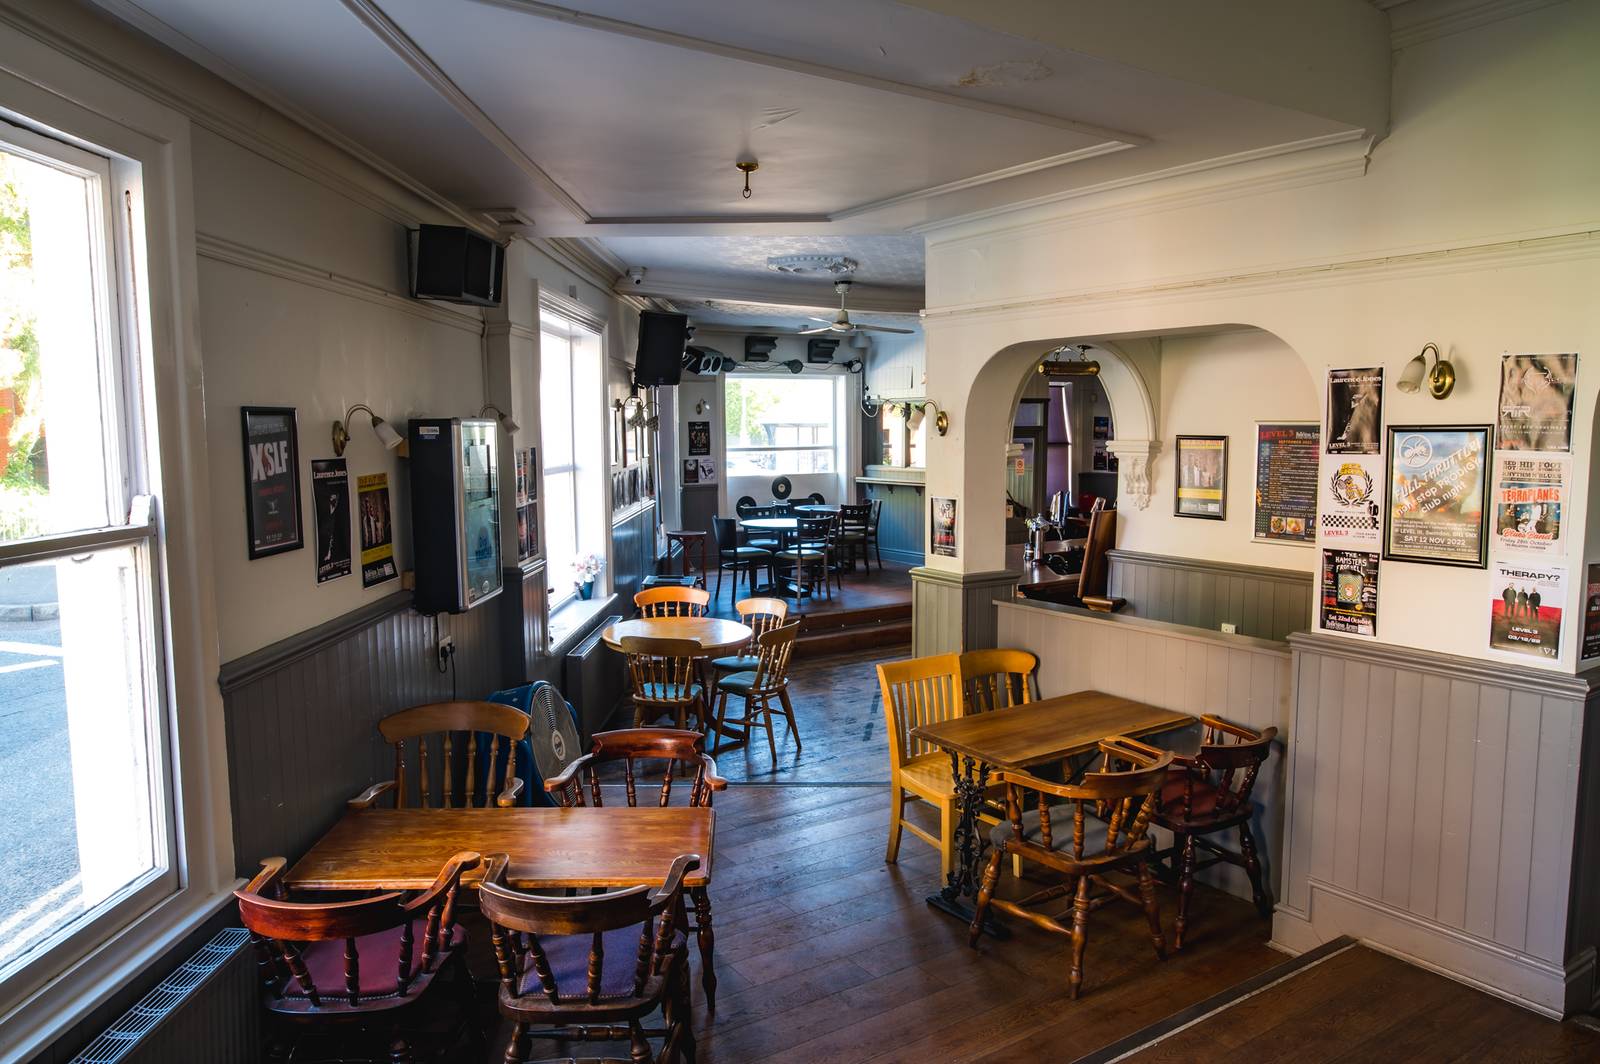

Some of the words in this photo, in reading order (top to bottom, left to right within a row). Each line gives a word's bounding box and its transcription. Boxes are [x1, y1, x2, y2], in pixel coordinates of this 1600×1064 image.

[1260, 431, 1289, 439] LEVEL
[249, 440, 288, 481] XSLF
[1416, 486, 1438, 503] stop
[1436, 455, 1480, 489] PRODIGY
[1420, 497, 1441, 513] club
[1442, 481, 1466, 502] night
[1502, 486, 1560, 503] TERRAPLANES
[1335, 556, 1367, 567] HAMSTERS
[1500, 568, 1560, 582] THERAPY?
[1512, 626, 1532, 634] LEVEL
